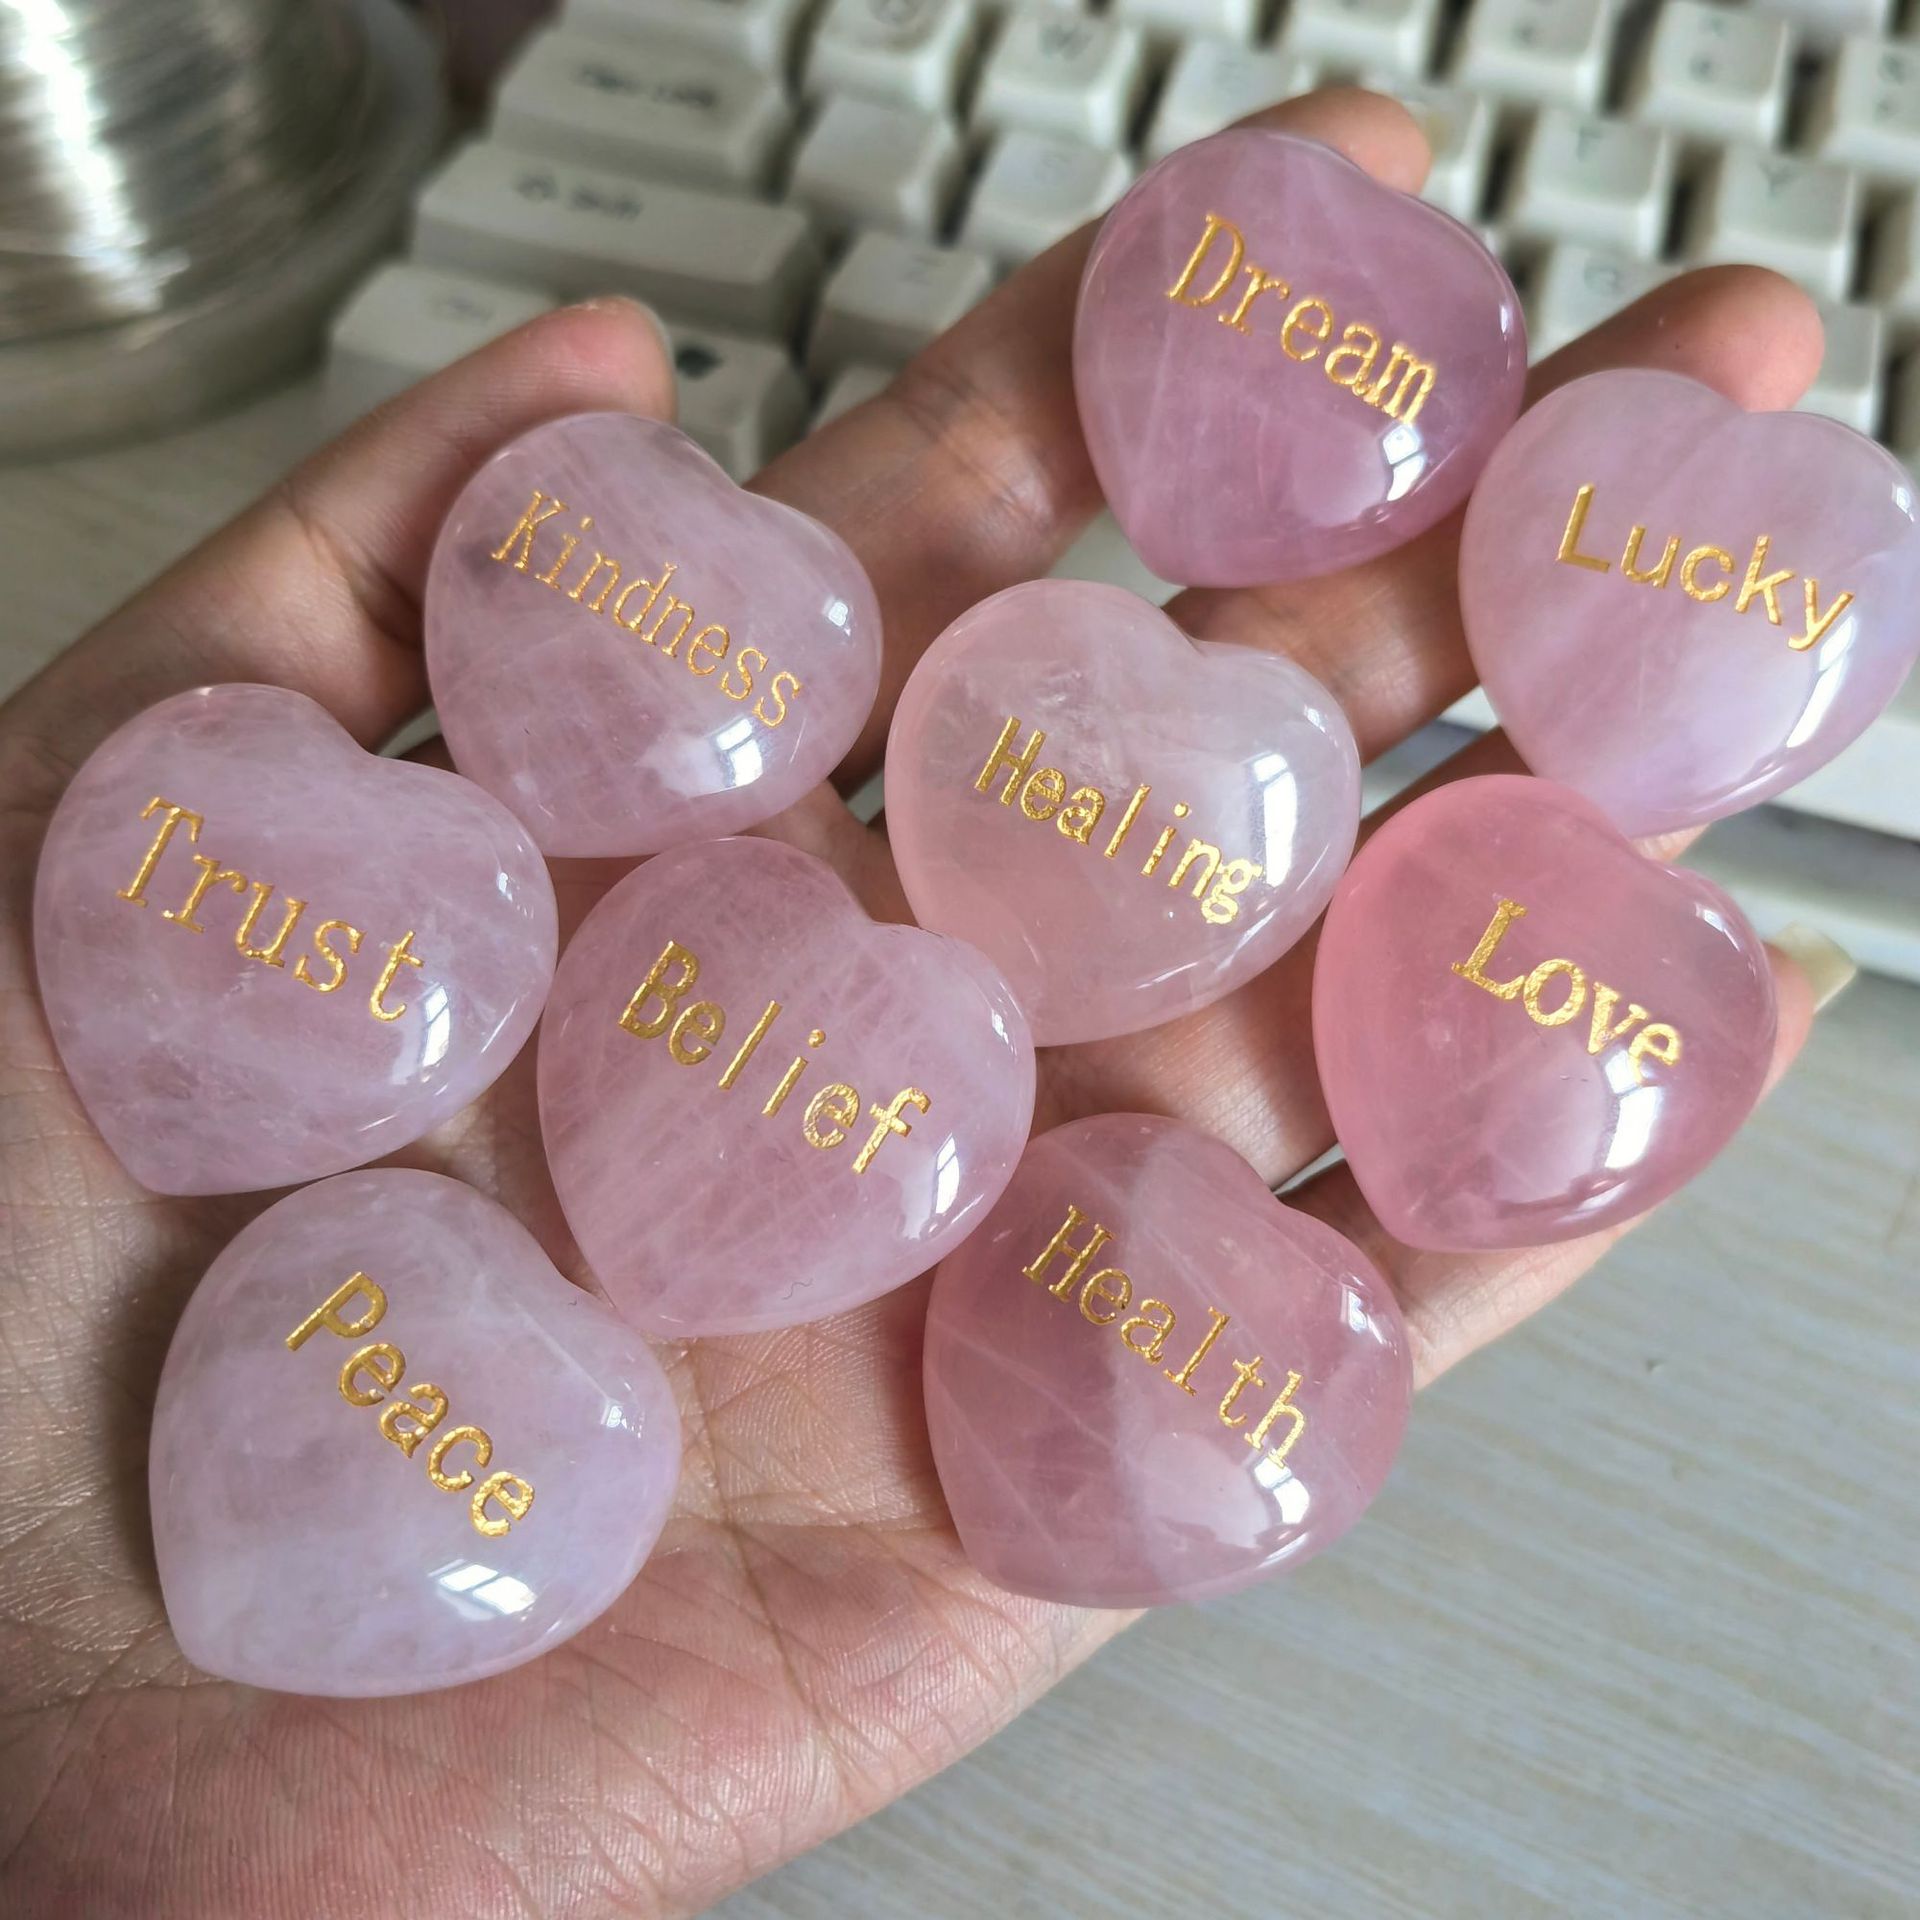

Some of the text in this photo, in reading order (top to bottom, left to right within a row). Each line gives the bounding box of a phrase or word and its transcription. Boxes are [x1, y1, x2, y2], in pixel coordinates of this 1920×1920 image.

[1167, 212, 1436, 424] Dream
[491, 490, 803, 728] Kindness
[1558, 483, 1853, 651] Lucky
[117, 797, 423, 1022] Trust
[974, 716, 1263, 924] Healing
[619, 942, 931, 1174] Belief
[1451, 899, 1682, 1087] Love
[285, 1271, 536, 1538] Peace
[1022, 1205, 1305, 1468] Health
